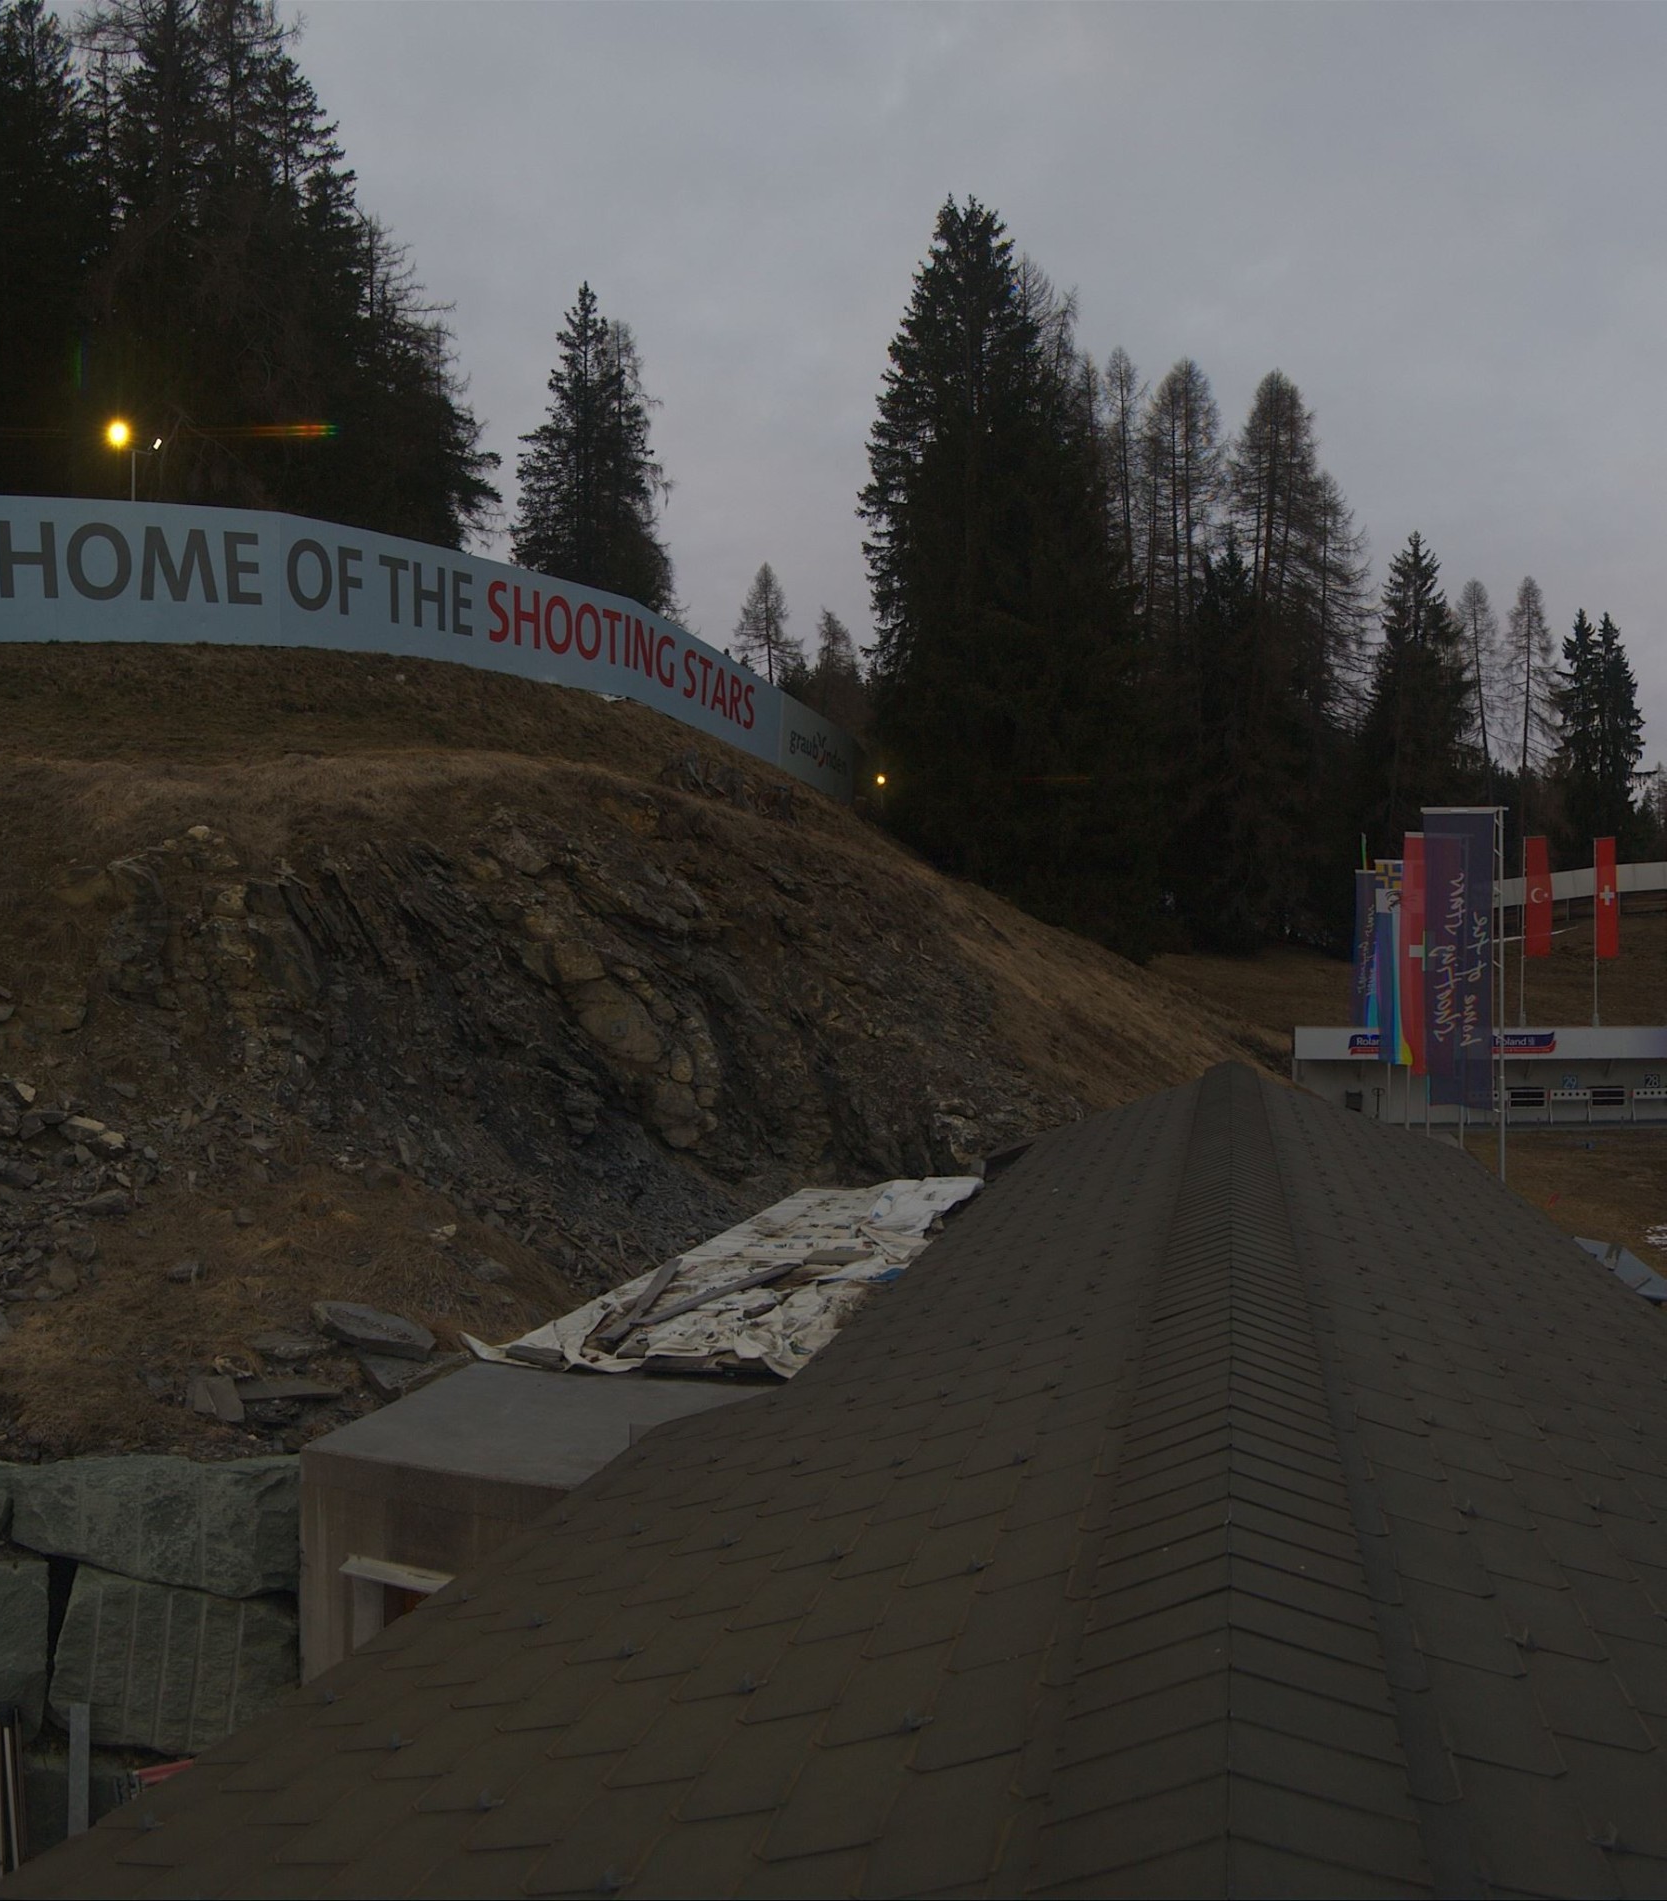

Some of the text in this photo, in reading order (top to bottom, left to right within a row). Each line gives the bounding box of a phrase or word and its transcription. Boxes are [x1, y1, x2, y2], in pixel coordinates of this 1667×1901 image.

[287, 538, 362, 616] OF
[378, 555, 473, 636] THE
[487, 580, 675, 688] SHOOTING
[683, 649, 755, 731] STARS
[1356, 1037, 1380, 1046] Rolan
[1563, 1076, 1576, 1088] 29
[1646, 1075, 1659, 1087] 28
